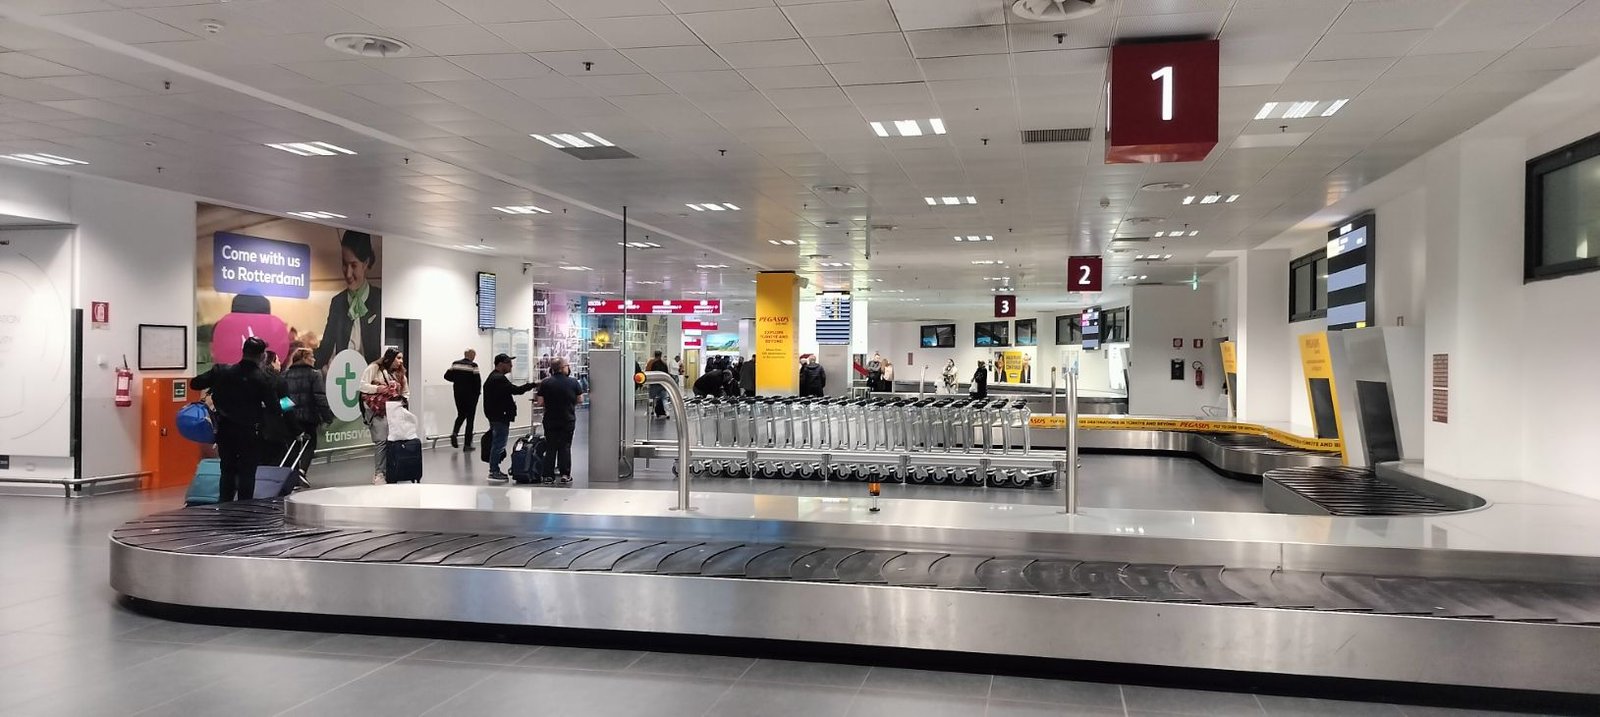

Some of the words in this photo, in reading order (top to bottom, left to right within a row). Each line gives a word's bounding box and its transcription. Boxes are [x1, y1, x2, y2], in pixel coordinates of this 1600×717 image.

[1152, 66, 1173, 120] 1
[222, 245, 257, 262] Come
[260, 252, 285, 266] with
[288, 258, 301, 268] us
[221, 266, 235, 280] to
[238, 266, 304, 287] Rotterdam!
[1078, 265, 1091, 285] 2
[1001, 300, 1009, 313] 3
[1179, 422, 1210, 430] PEGASUS
